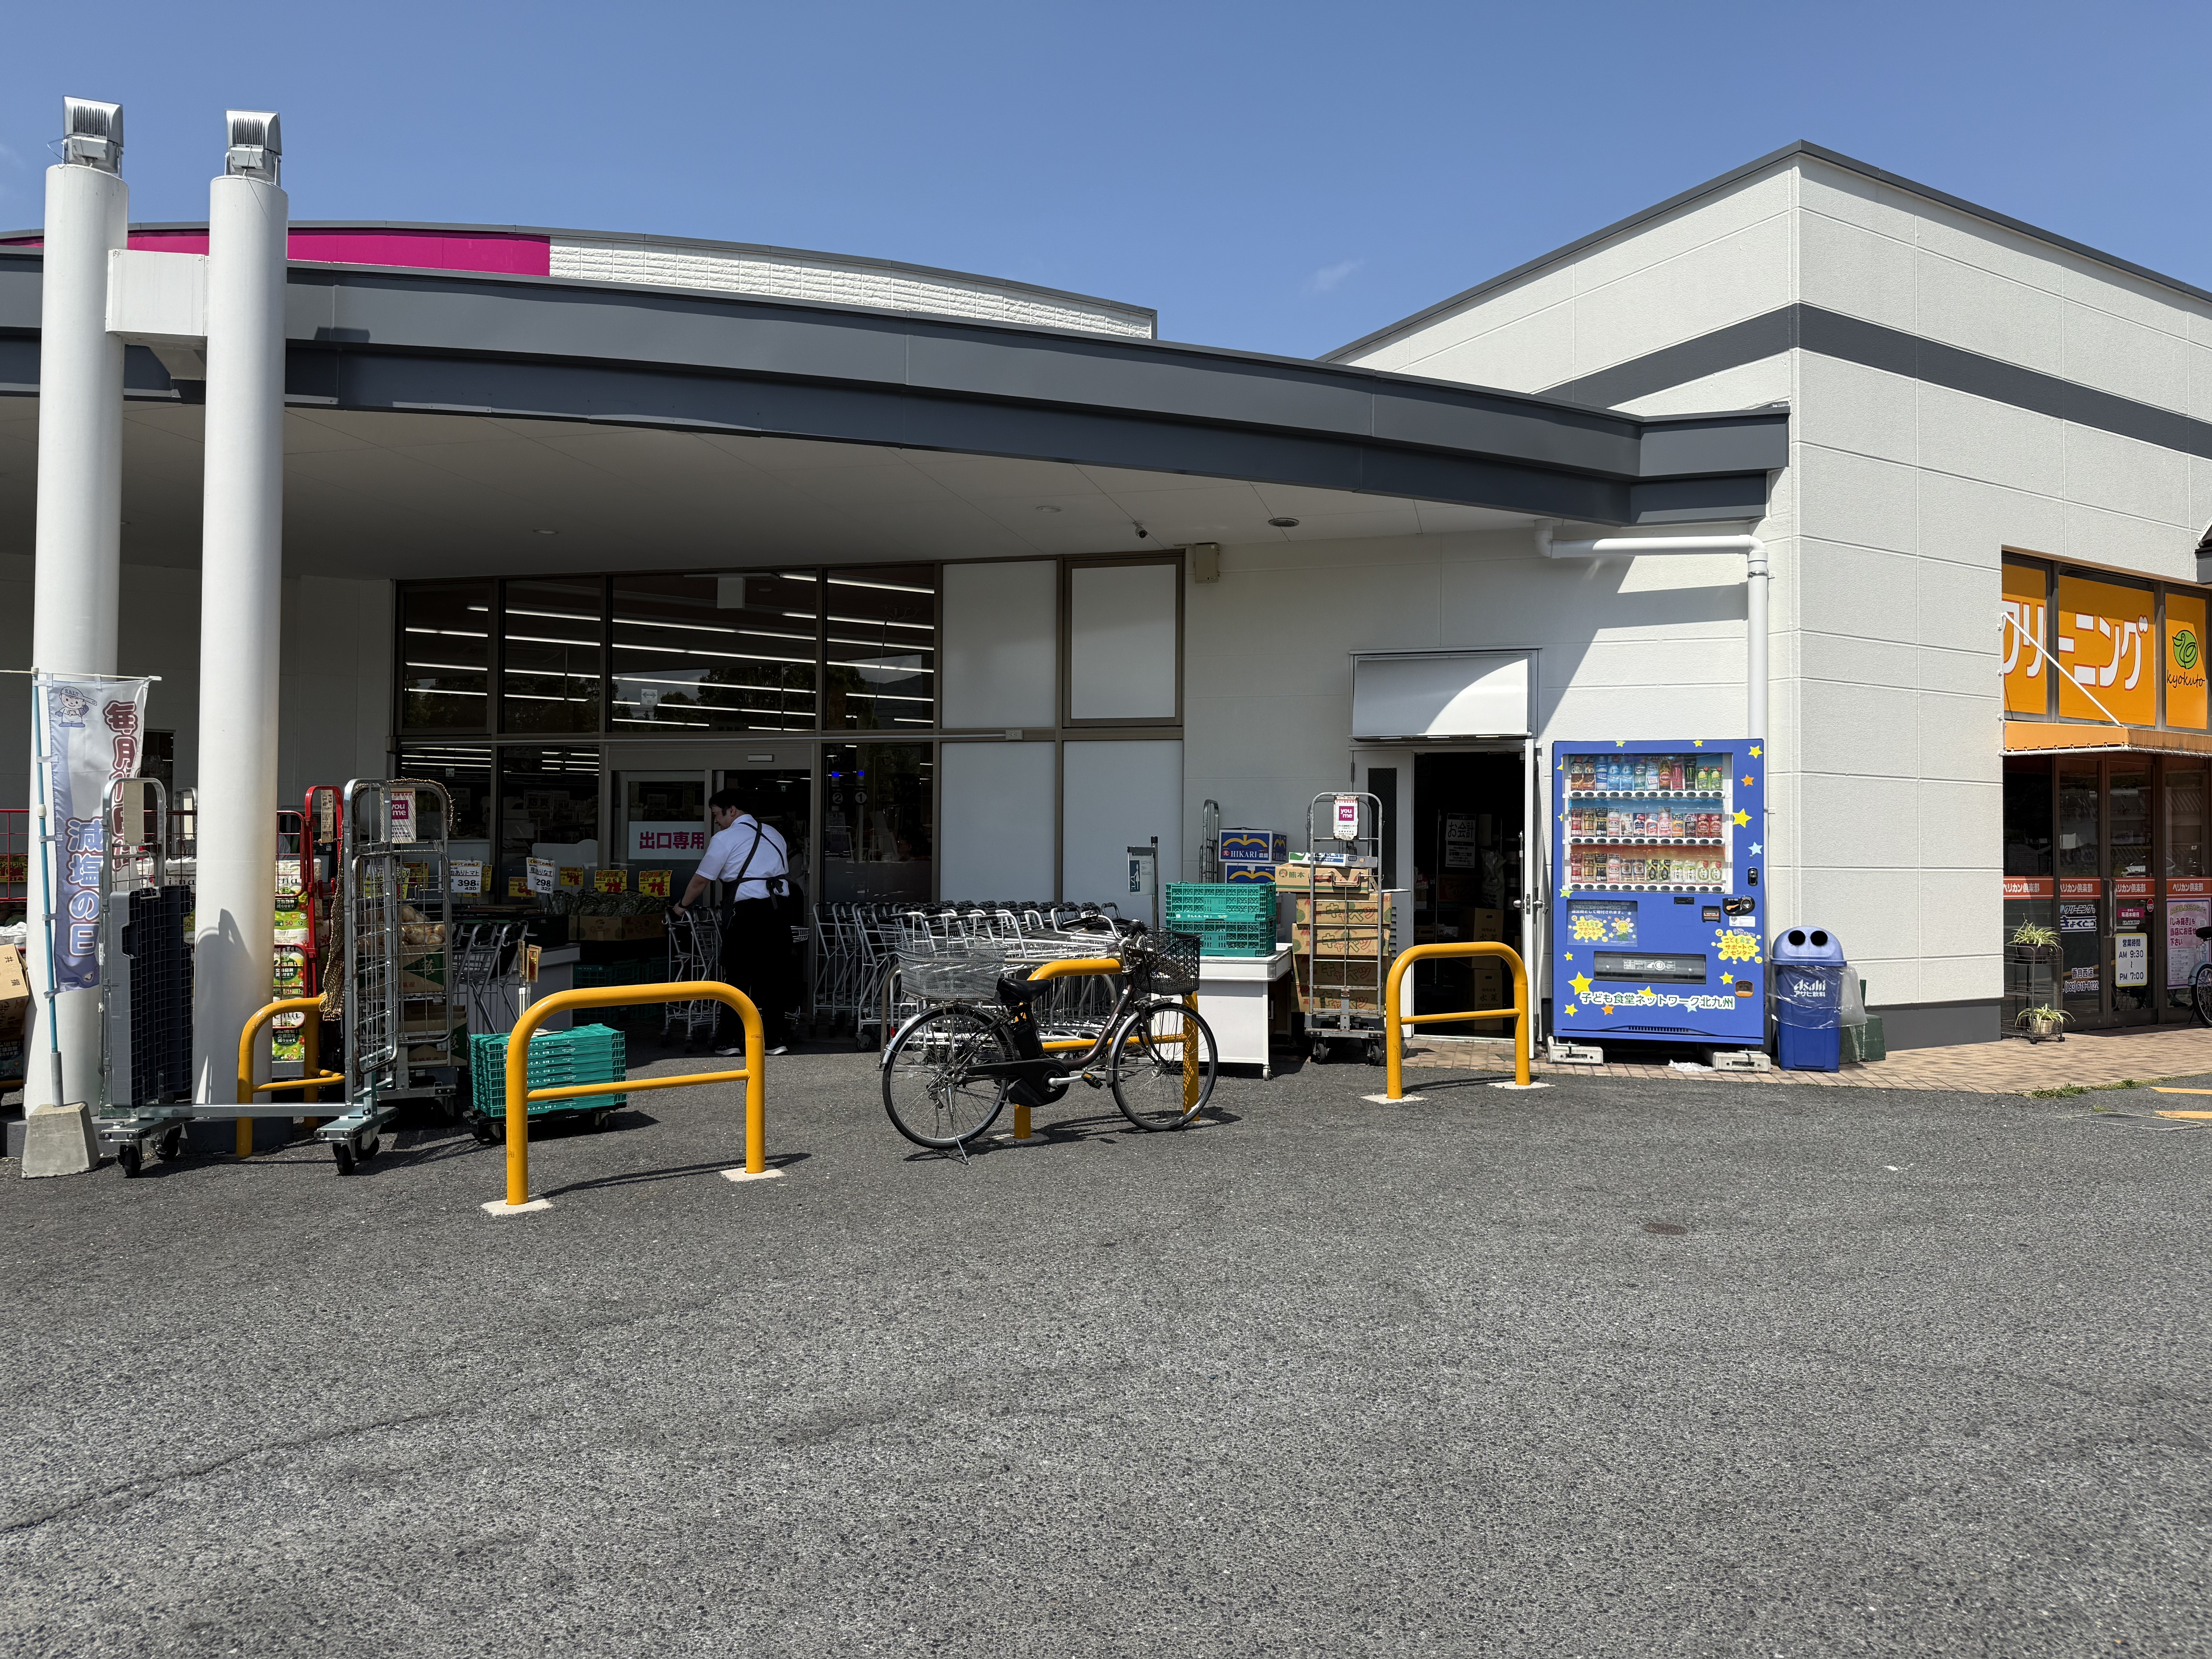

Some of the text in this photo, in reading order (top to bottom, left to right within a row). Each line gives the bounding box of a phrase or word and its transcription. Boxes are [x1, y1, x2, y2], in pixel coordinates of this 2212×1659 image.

[2167, 670, 2205, 688] kyokuto
[65, 689, 79, 697] SALT
[1448, 821, 1474, 838] お会計
[639, 831, 704, 850] 出口専用
[66, 817, 103, 957] 減塩の日
[536, 879, 551, 887] 298
[1326, 903, 1376, 922] キャベツ
[2060, 915, 2096, 929] きょくとう
[2170, 928, 2197, 936] 当店にお任せ
[1322, 933, 1372, 953] キャベツ
[2123, 939, 2141, 947] 営業時間
[2170, 938, 2183, 946] 下さい
[2130, 950, 2143, 958] 9:30
[1321, 962, 1371, 981] キャベツ
[2071, 967, 2094, 979] 香月西店
[2130, 972, 2144, 980] 7:00
[1793, 979, 1826, 991] Asahi
[1581, 993, 1733, 1008] 子ども食堂ネットワーク北九州
